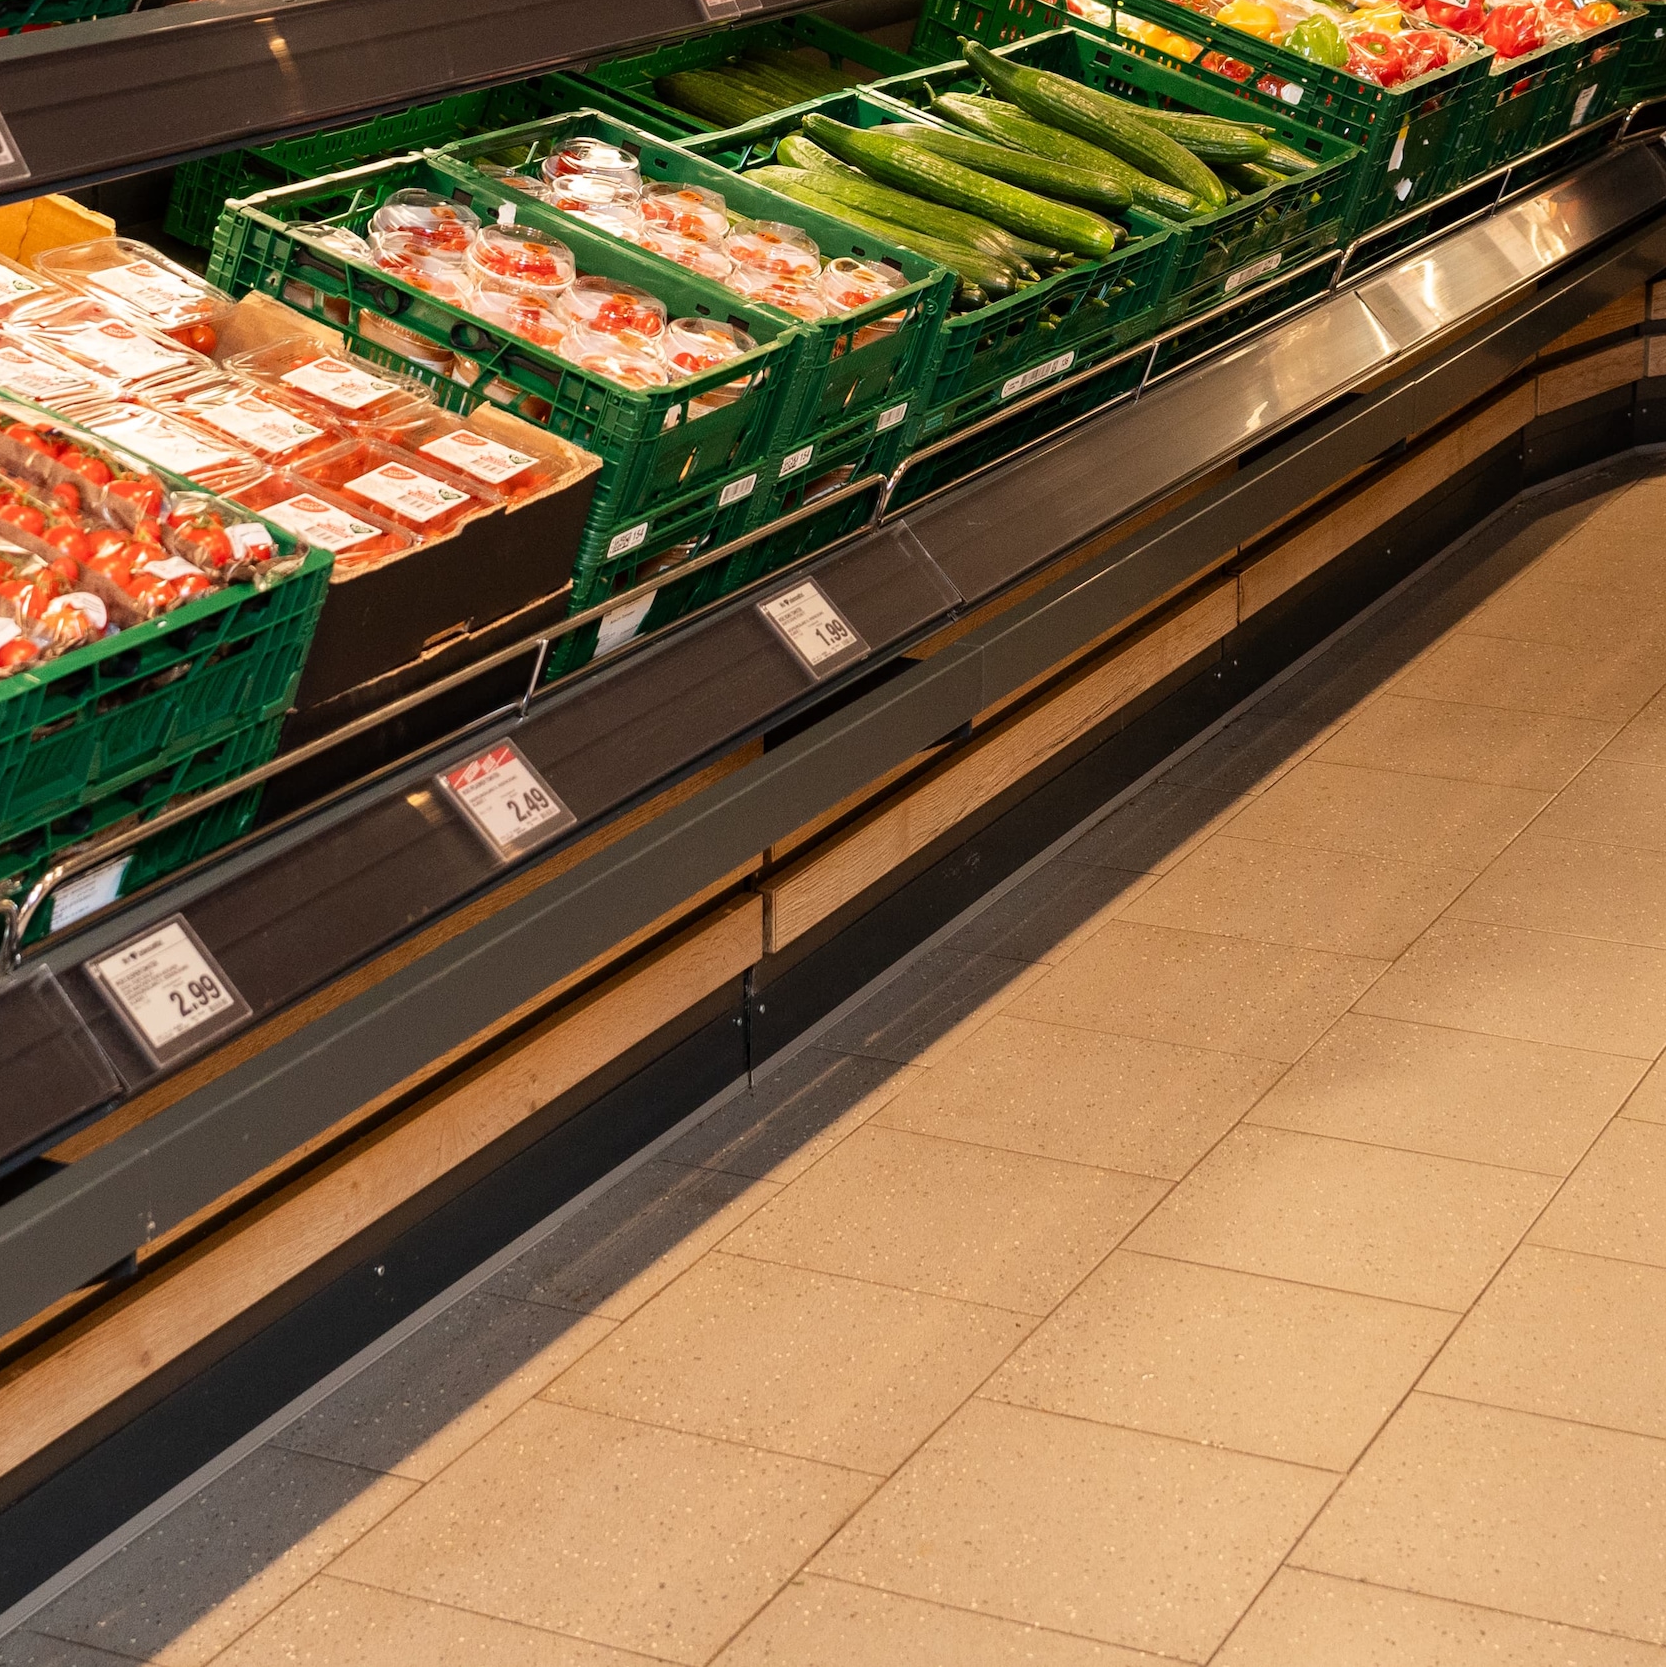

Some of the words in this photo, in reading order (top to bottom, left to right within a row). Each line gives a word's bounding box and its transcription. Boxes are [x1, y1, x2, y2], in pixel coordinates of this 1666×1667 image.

[815, 619, 849, 646] 1.99
[506, 787, 549, 822] 2.49
[169, 973, 221, 1017] 2.99
